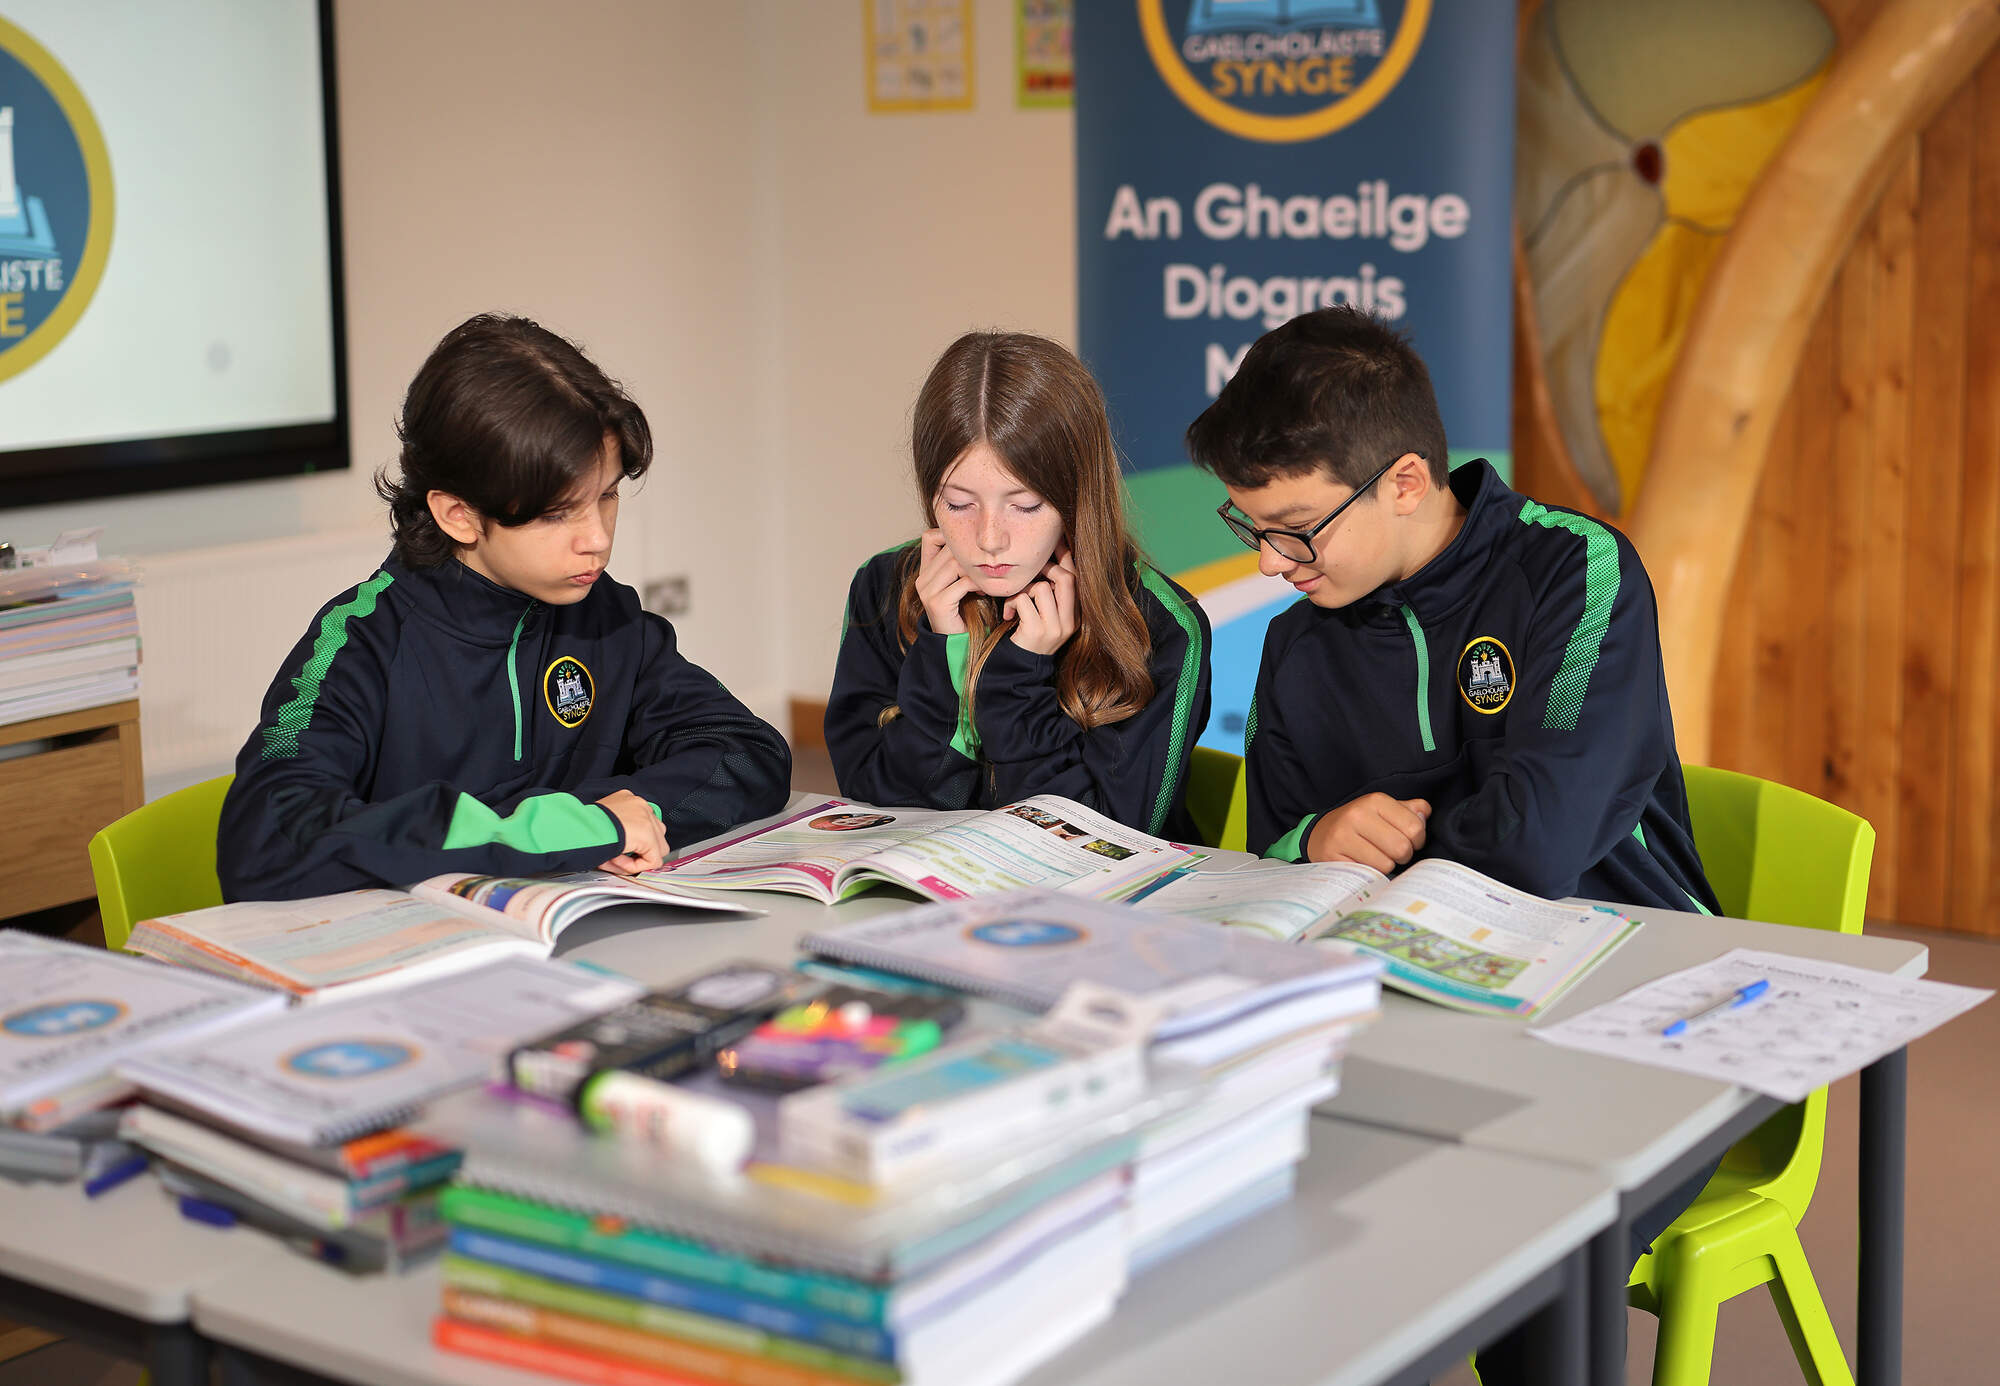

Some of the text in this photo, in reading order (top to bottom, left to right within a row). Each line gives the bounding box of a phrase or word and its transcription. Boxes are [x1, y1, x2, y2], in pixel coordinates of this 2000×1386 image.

[1212, 57, 1353, 97] SYNGE
[1105, 180, 1470, 252] An Ghaeilge
[1163, 264, 1406, 328] Díograis
[564, 706, 586, 720] SYNGE
[1475, 692, 1504, 705] SYNGE
